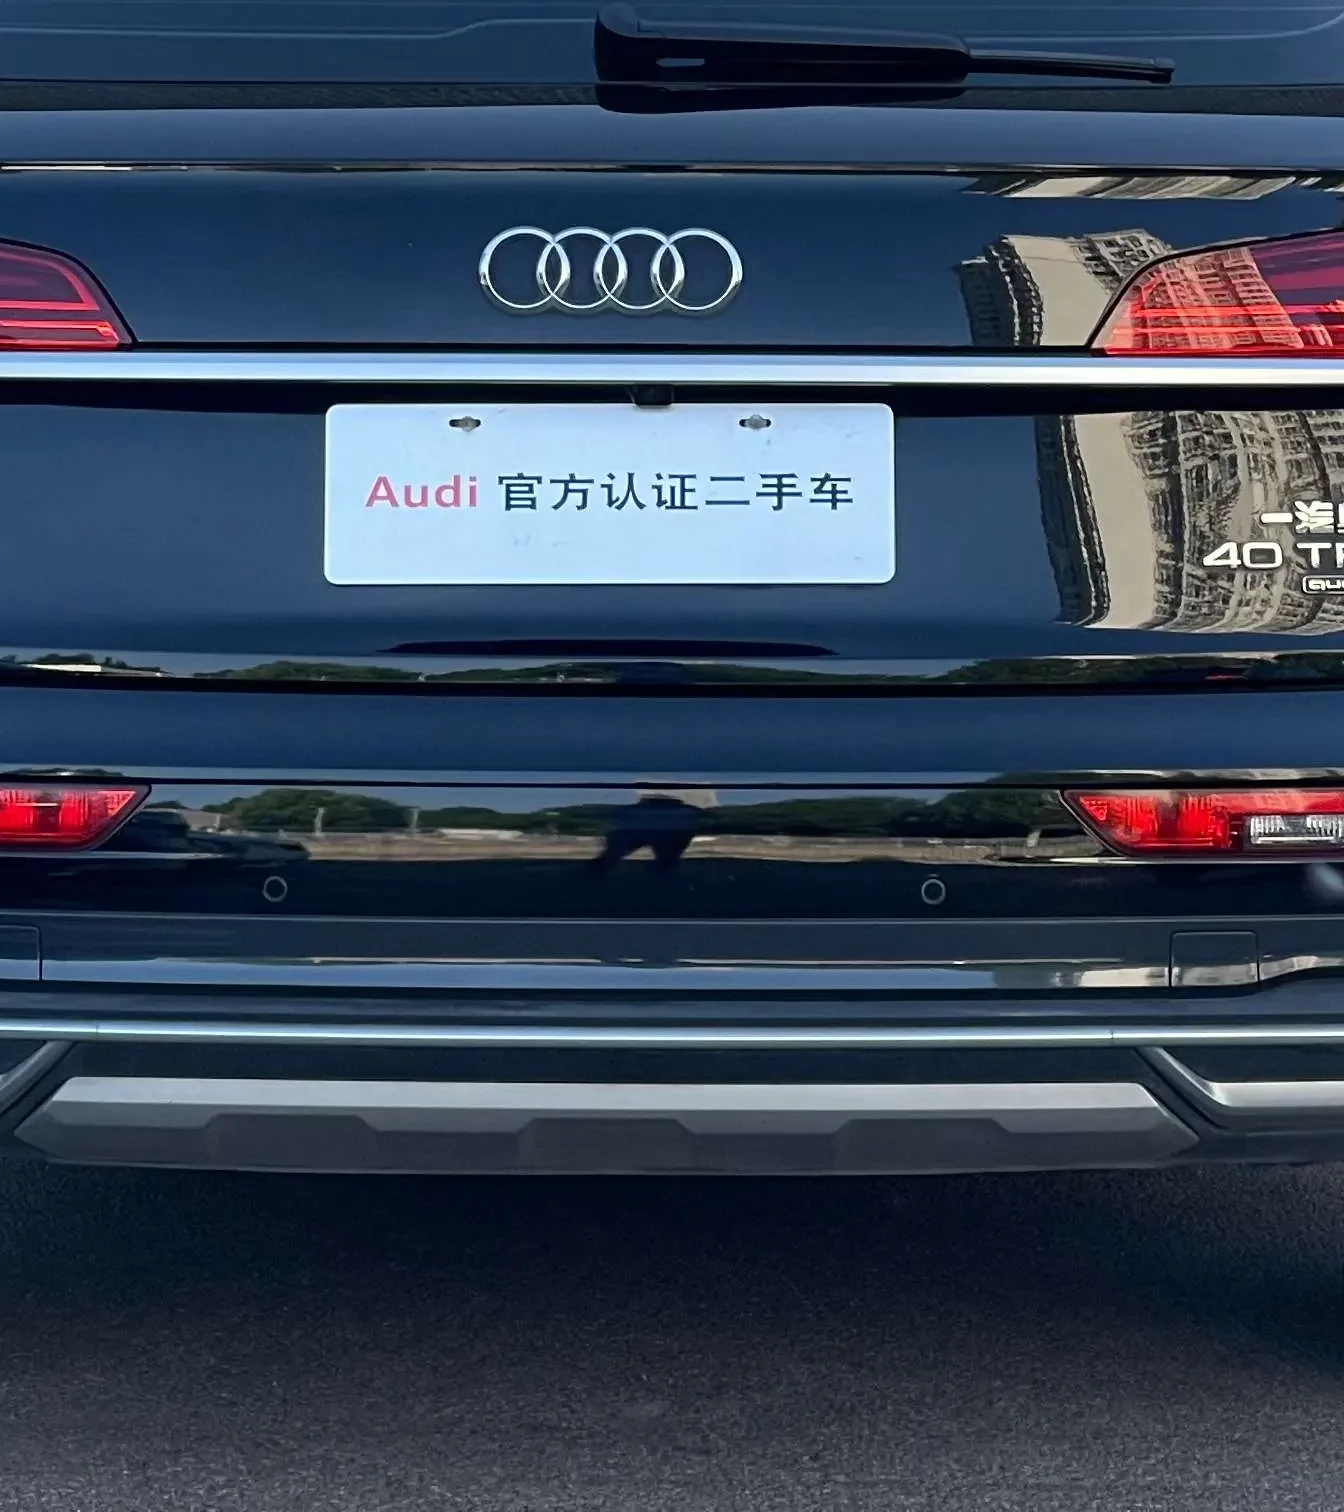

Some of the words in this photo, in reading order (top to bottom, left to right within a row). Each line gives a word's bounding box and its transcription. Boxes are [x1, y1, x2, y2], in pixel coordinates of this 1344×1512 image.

[365, 475, 478, 509] Audi
[497, 472, 854, 511] 官方认证二手车
[1203, 541, 1283, 570] 40
